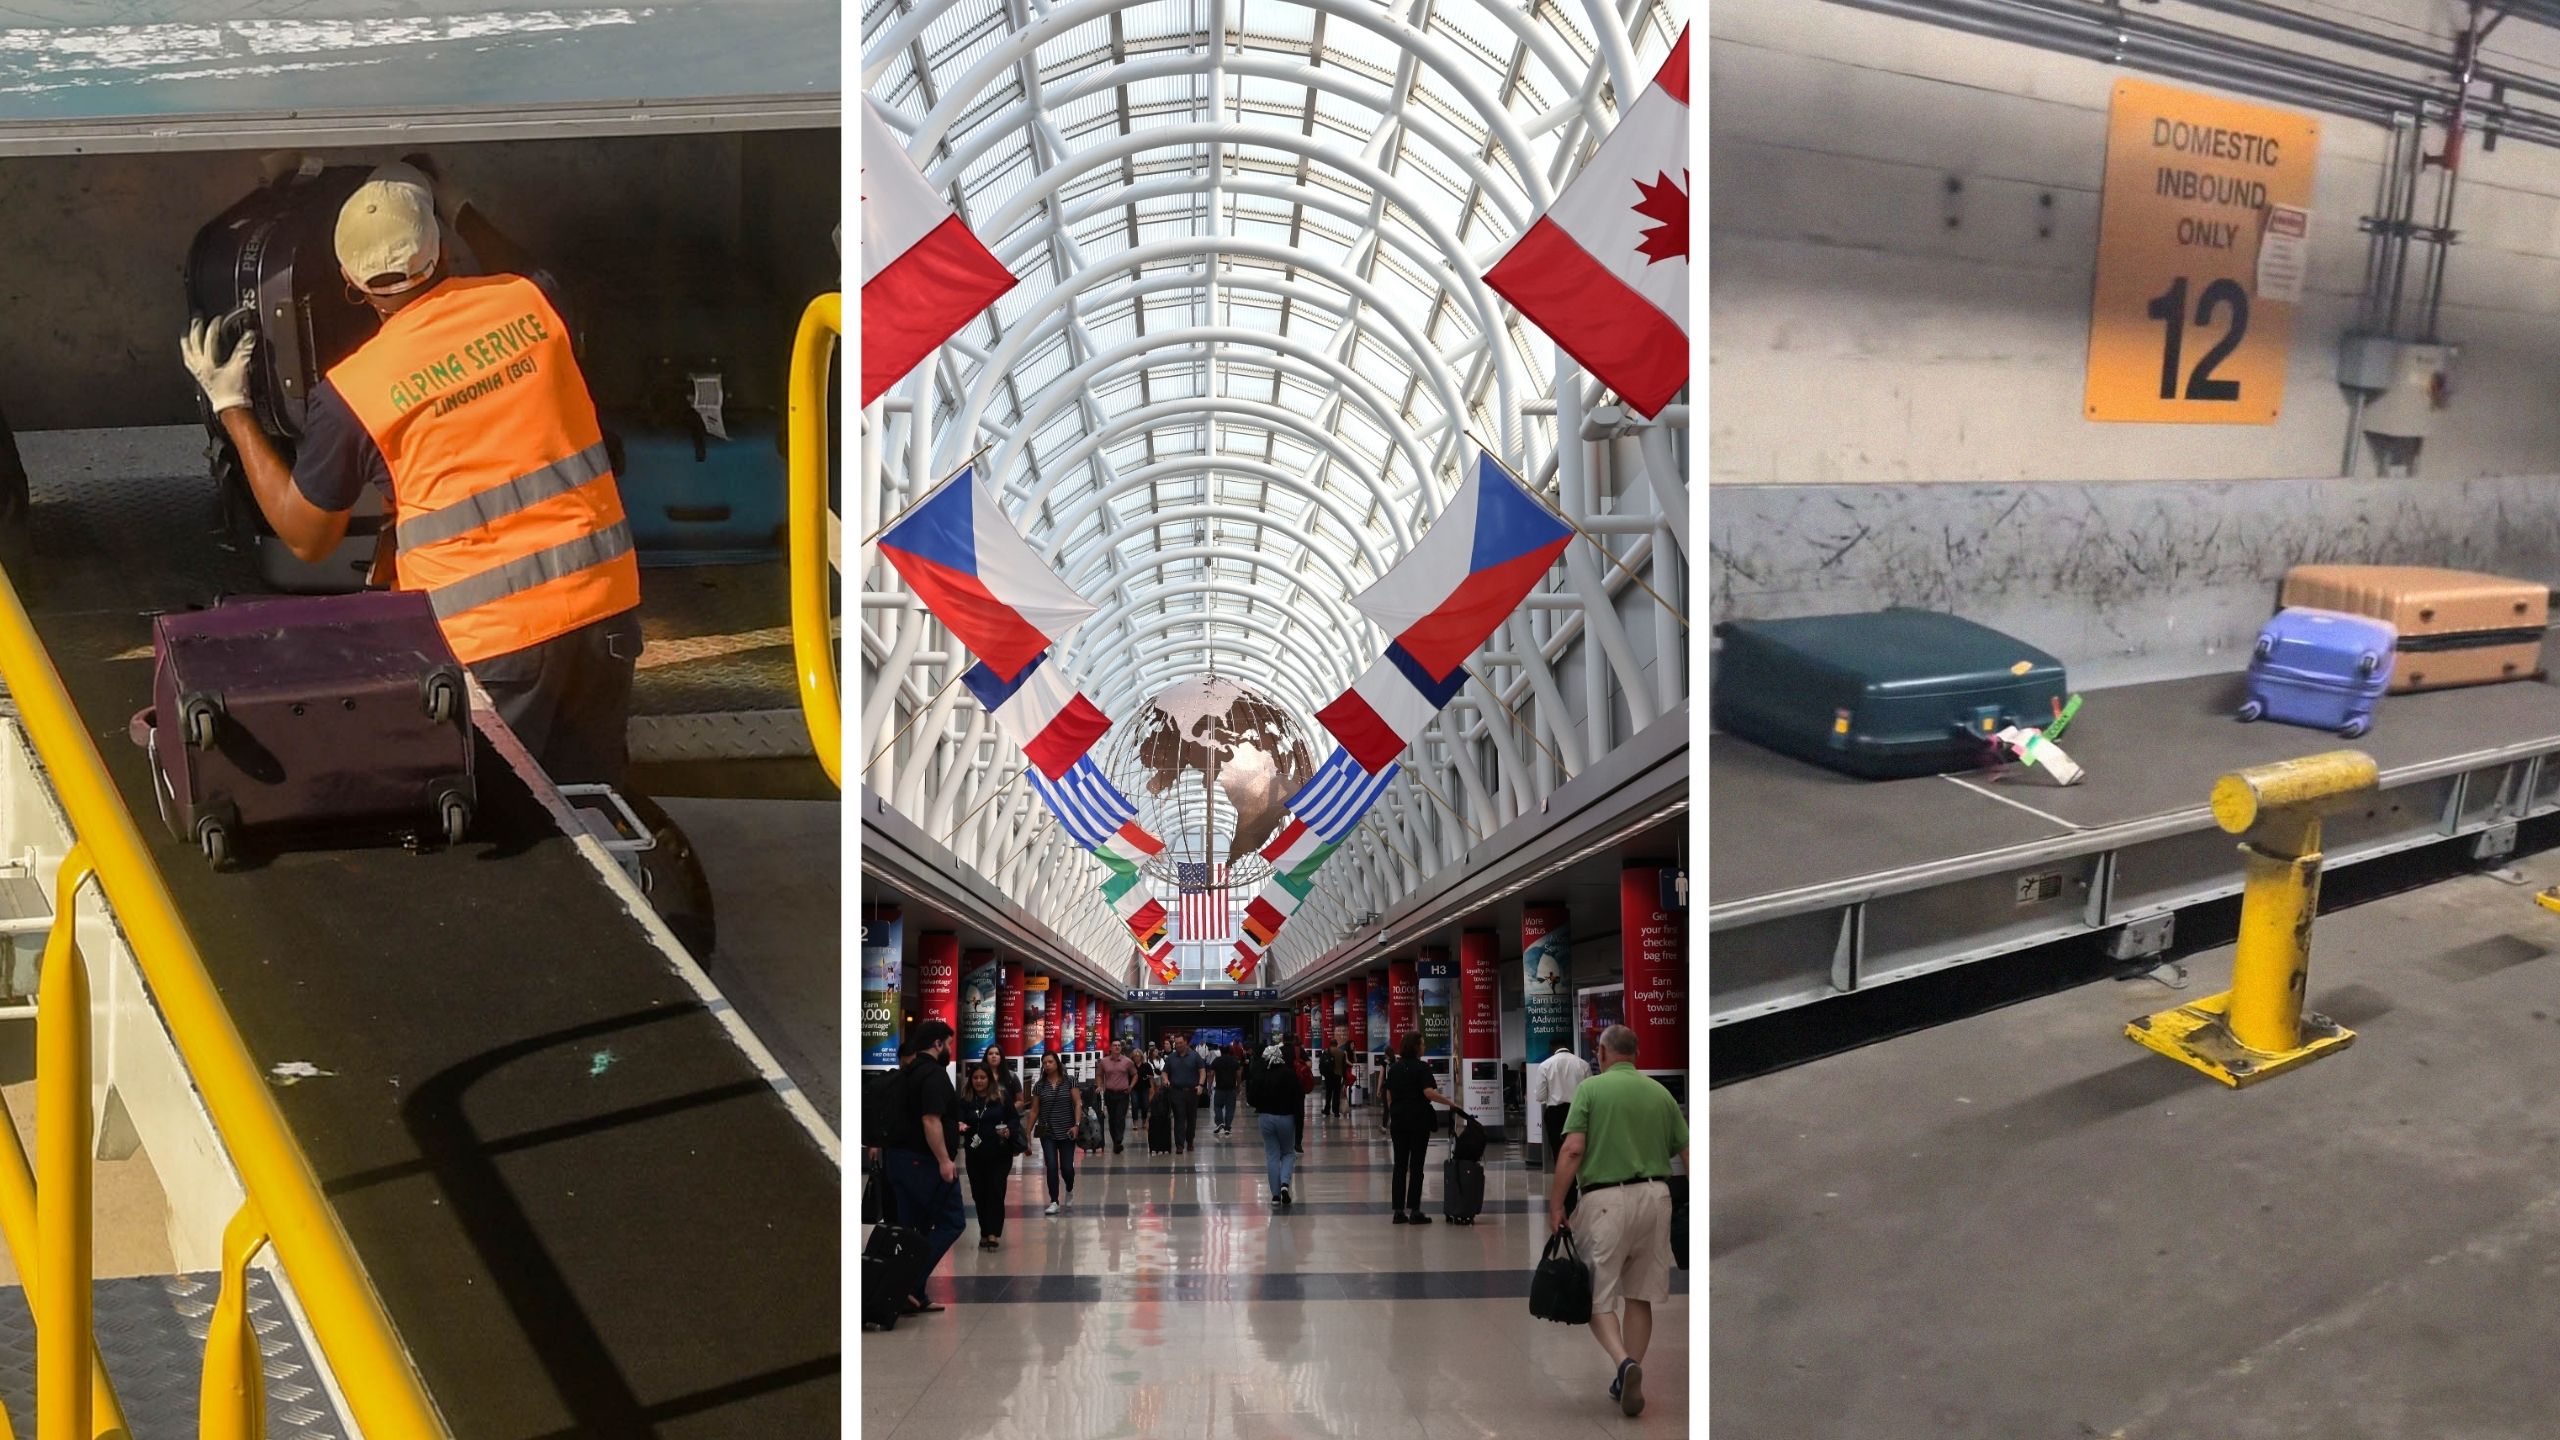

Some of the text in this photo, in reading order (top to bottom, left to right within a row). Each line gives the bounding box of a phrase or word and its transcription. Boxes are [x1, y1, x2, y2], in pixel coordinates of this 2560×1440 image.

[2153, 117, 2279, 167] DOMESTIC
[2156, 167, 2267, 210] INBOUND
[2178, 217, 2240, 249] ONLY
[2147, 276, 2249, 401] 12
[390, 313, 548, 414] ALPINA SERVICE
[434, 355, 538, 418] ZINGONIA (BG)
[1652, 912, 1668, 921] Get
[1525, 927, 1546, 935] Status
[1641, 926, 1661, 937] your
[1643, 938, 1677, 947] checked
[1643, 951, 1660, 962] bag
[1431, 965, 1447, 975] H3
[1652, 977, 1672, 986] Earn
[1634, 990, 1664, 1001] Loyalty
[1528, 1006, 1547, 1014] Points
[1647, 1004, 1677, 1012] toward
[1425, 1018, 1449, 1027] 70,000
[872, 1029, 888, 1037] miles
